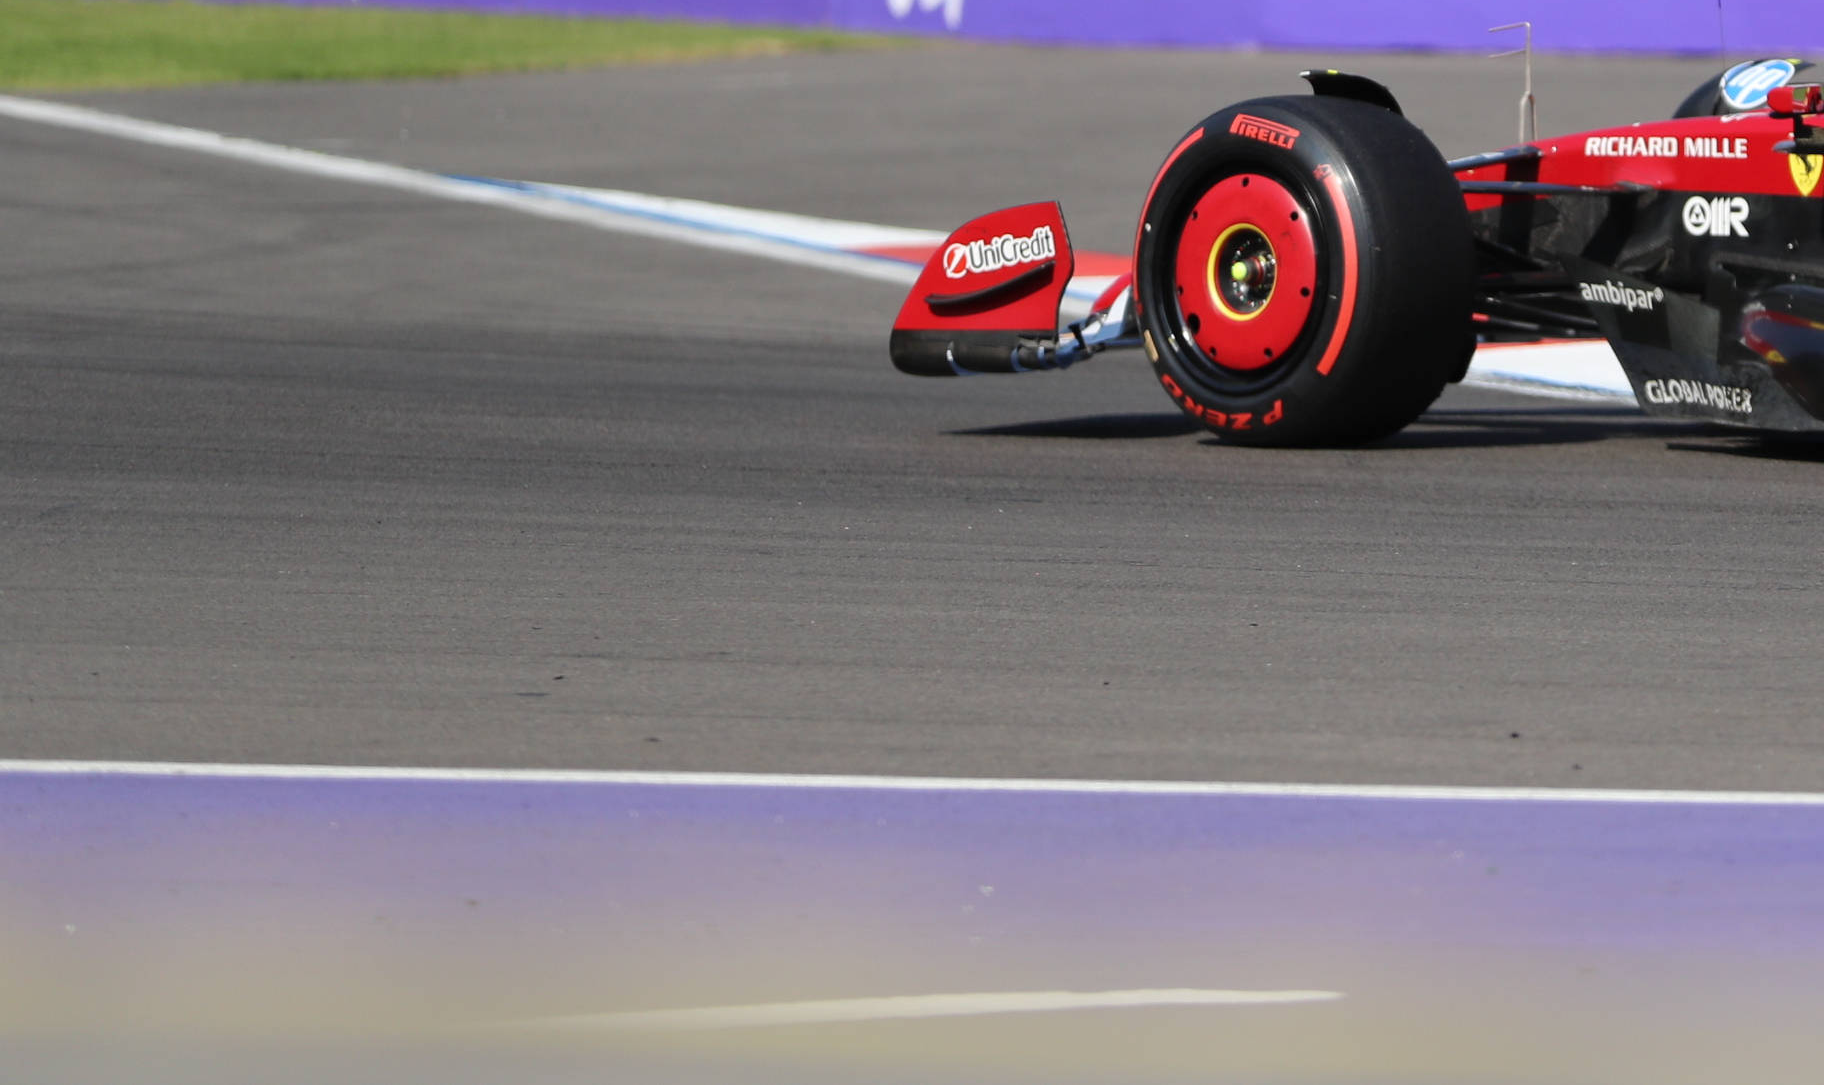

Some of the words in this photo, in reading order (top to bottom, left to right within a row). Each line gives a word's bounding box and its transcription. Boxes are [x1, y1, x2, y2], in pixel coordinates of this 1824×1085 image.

[1229, 113, 1301, 149] PIRELLI
[1584, 135, 1679, 157] RICHARD
[1683, 136, 1749, 159] MILLE
[967, 228, 1054, 270] UniCredit
[1160, 372, 1254, 431] ZERO
[1644, 378, 1708, 405] GLOBAL
